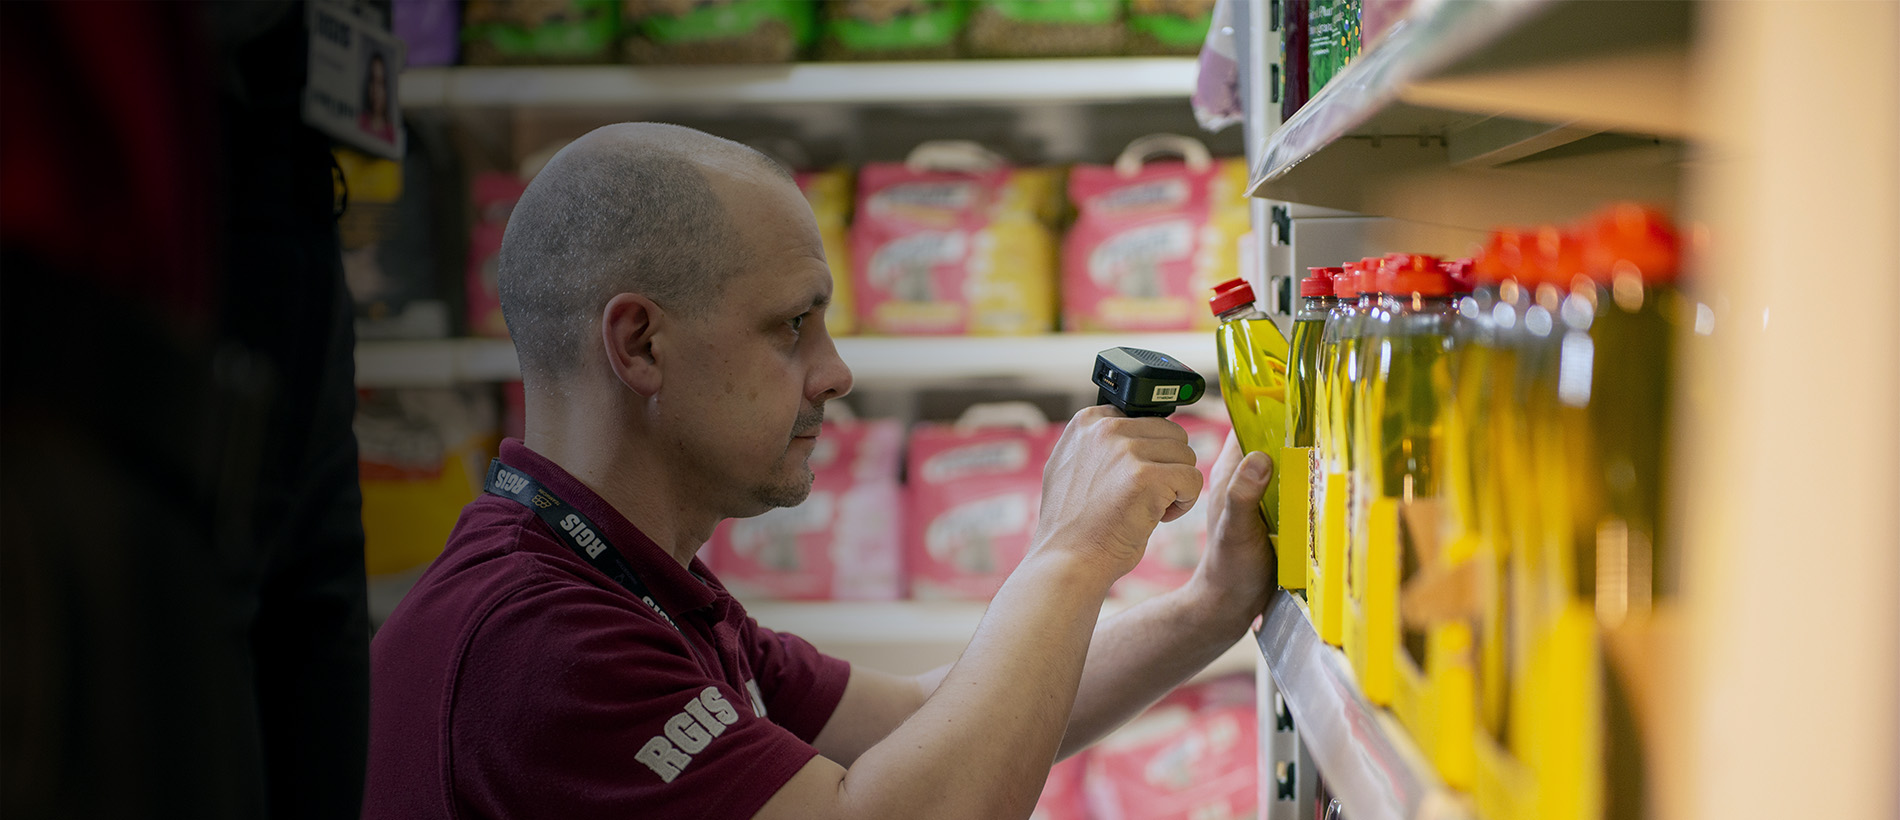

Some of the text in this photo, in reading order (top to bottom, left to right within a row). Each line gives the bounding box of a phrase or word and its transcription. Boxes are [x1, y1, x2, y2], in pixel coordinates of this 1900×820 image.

[495, 469, 529, 495] RGIS
[559, 513, 608, 560] RGIS
[634, 686, 740, 784] RGIS
